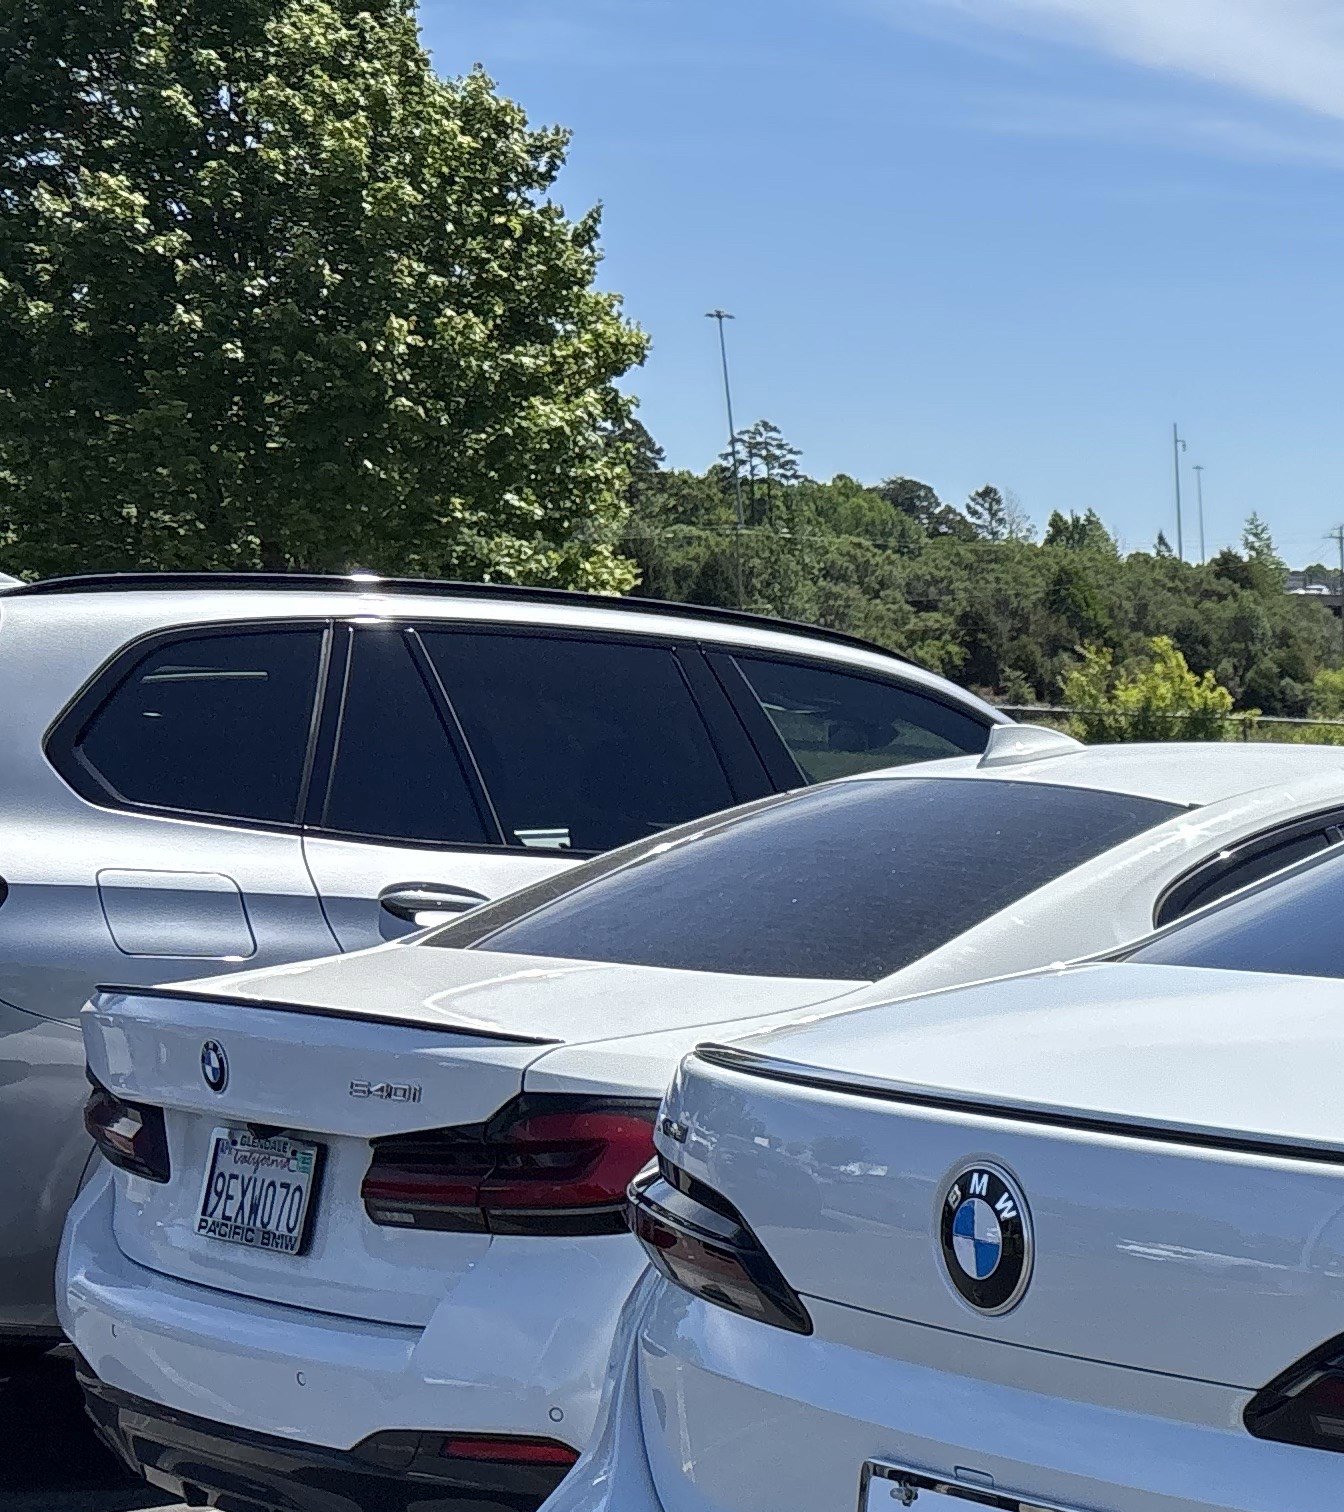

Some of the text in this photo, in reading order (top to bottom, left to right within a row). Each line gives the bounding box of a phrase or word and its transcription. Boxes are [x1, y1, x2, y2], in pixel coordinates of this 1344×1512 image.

[349, 1079, 422, 1103] 540i
[240, 1135, 289, 1153] GLENDALE
[207, 1171, 303, 1234] 9EXW070
[948, 1172, 1017, 1221] BMW
[198, 1218, 298, 1252] PACIFIC BMW
